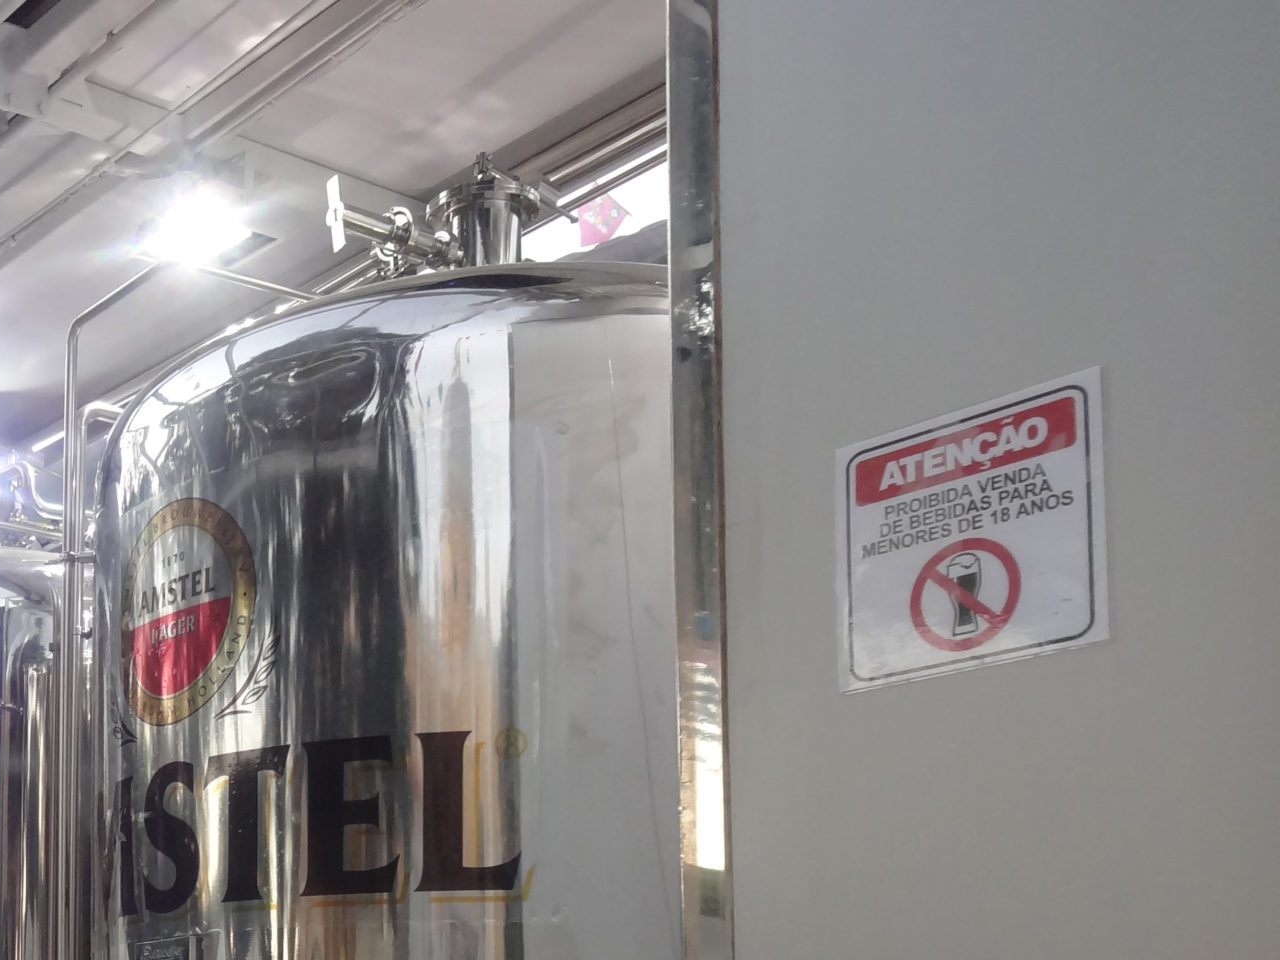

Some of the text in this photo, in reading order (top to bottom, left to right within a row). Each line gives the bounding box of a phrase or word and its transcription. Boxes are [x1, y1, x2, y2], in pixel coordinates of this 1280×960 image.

[879, 416, 1049, 491] ATENÇÃO
[879, 479, 1053, 539] DE BEBIDAS PARA
[884, 463, 1047, 520] PROIBIDA VENDA
[861, 490, 1075, 559] MENORES DE 18 ANOS
[139, 567, 216, 619] AMSTEL
[151, 614, 197, 647] LAGER
